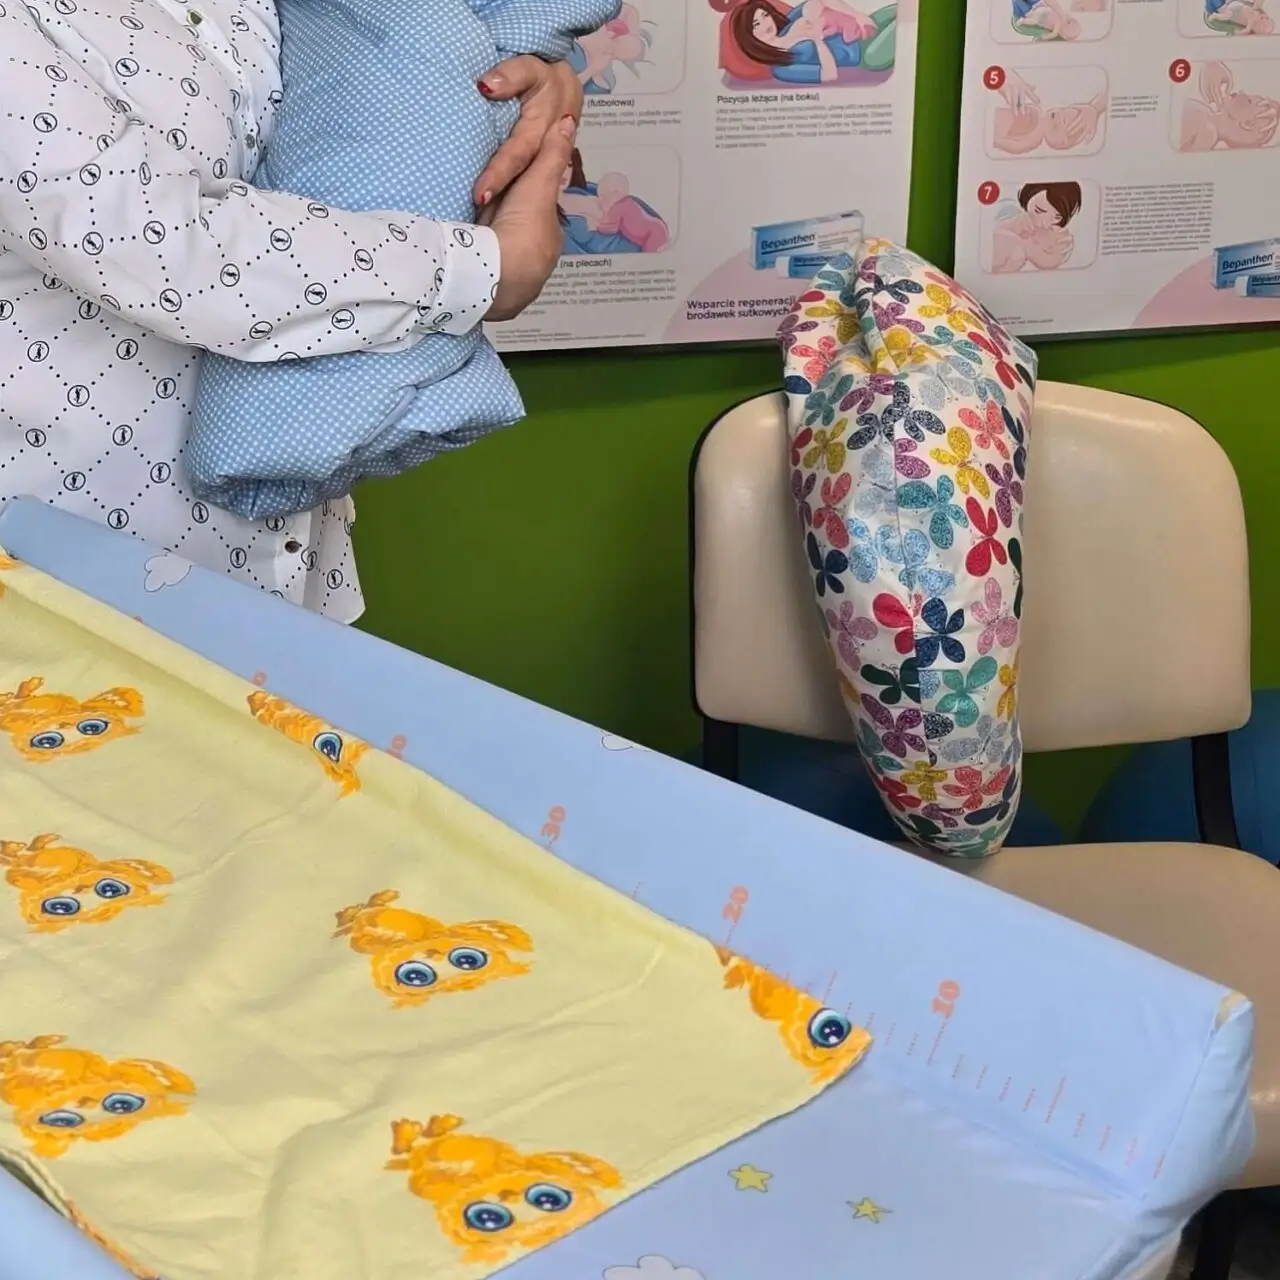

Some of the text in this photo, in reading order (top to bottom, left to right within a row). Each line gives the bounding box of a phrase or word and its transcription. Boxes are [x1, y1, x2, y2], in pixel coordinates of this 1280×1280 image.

[1175, 63, 1186, 77] 6
[988, 71, 1000, 84] 5
[717, 95, 750, 105] Pozycja
[781, 93, 794, 103] (na
[796, 93, 820, 102] boku)
[982, 186, 994, 200] 7
[560, 258, 612, 269] (na plecach)
[687, 299, 736, 310] Wsparcie
[687, 306, 790, 320] brodawek sutkowych
